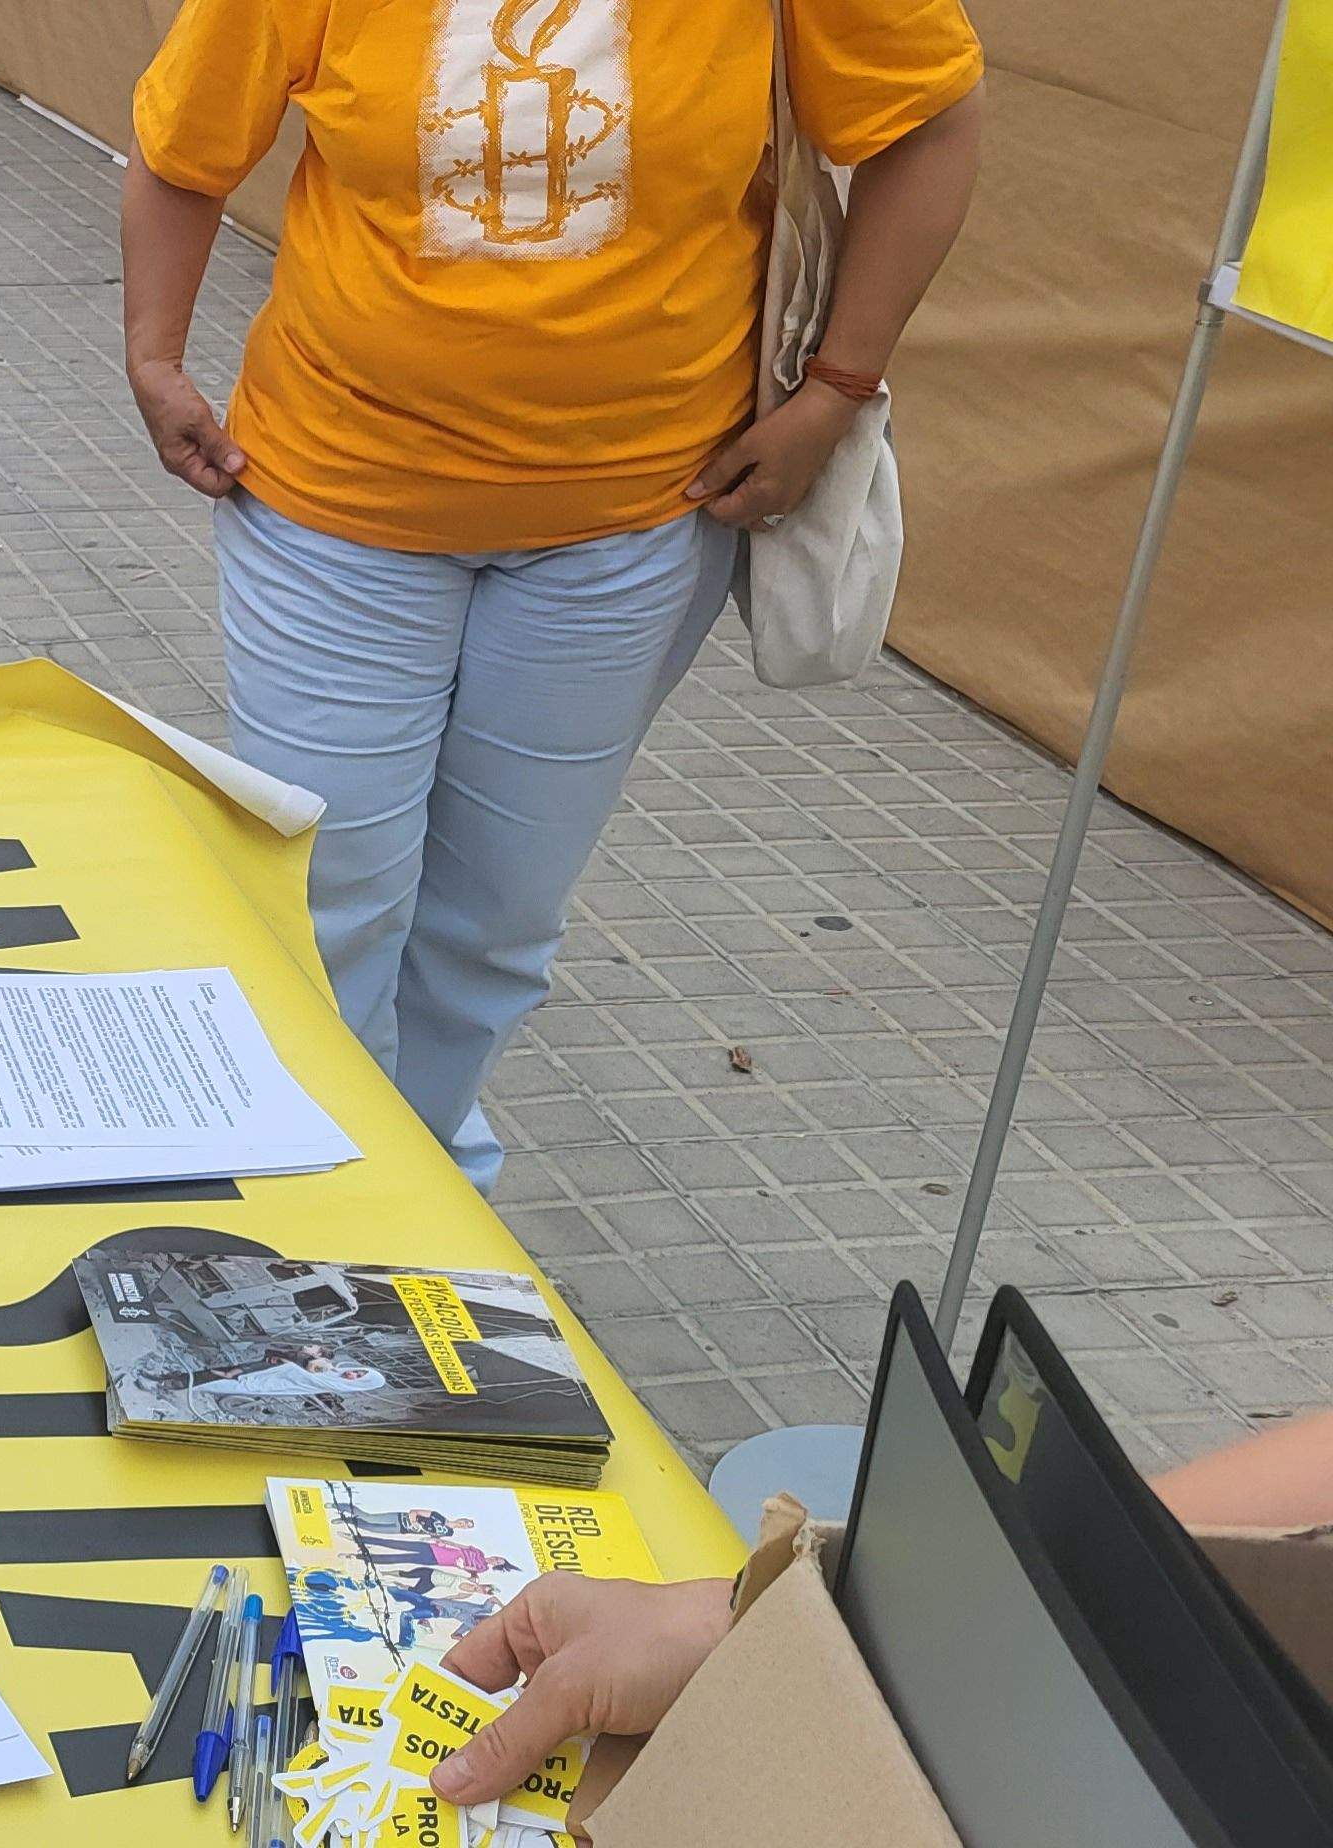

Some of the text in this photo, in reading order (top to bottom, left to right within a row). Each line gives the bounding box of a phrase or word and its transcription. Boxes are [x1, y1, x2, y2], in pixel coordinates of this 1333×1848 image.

[398, 1283, 418, 1297] LAS
[407, 1297, 441, 1339] PERSONAS
[429, 1340, 469, 1392] REFUGIADAS
[534, 1504, 567, 1525] DE
[564, 1505, 602, 1536] RED
[409, 1682, 483, 1735] TESTA
[545, 1756, 567, 1772] LA
[517, 1772, 575, 1804] PRO
[391, 1813, 411, 1837] LA
[416, 1796, 440, 1848] PRO
